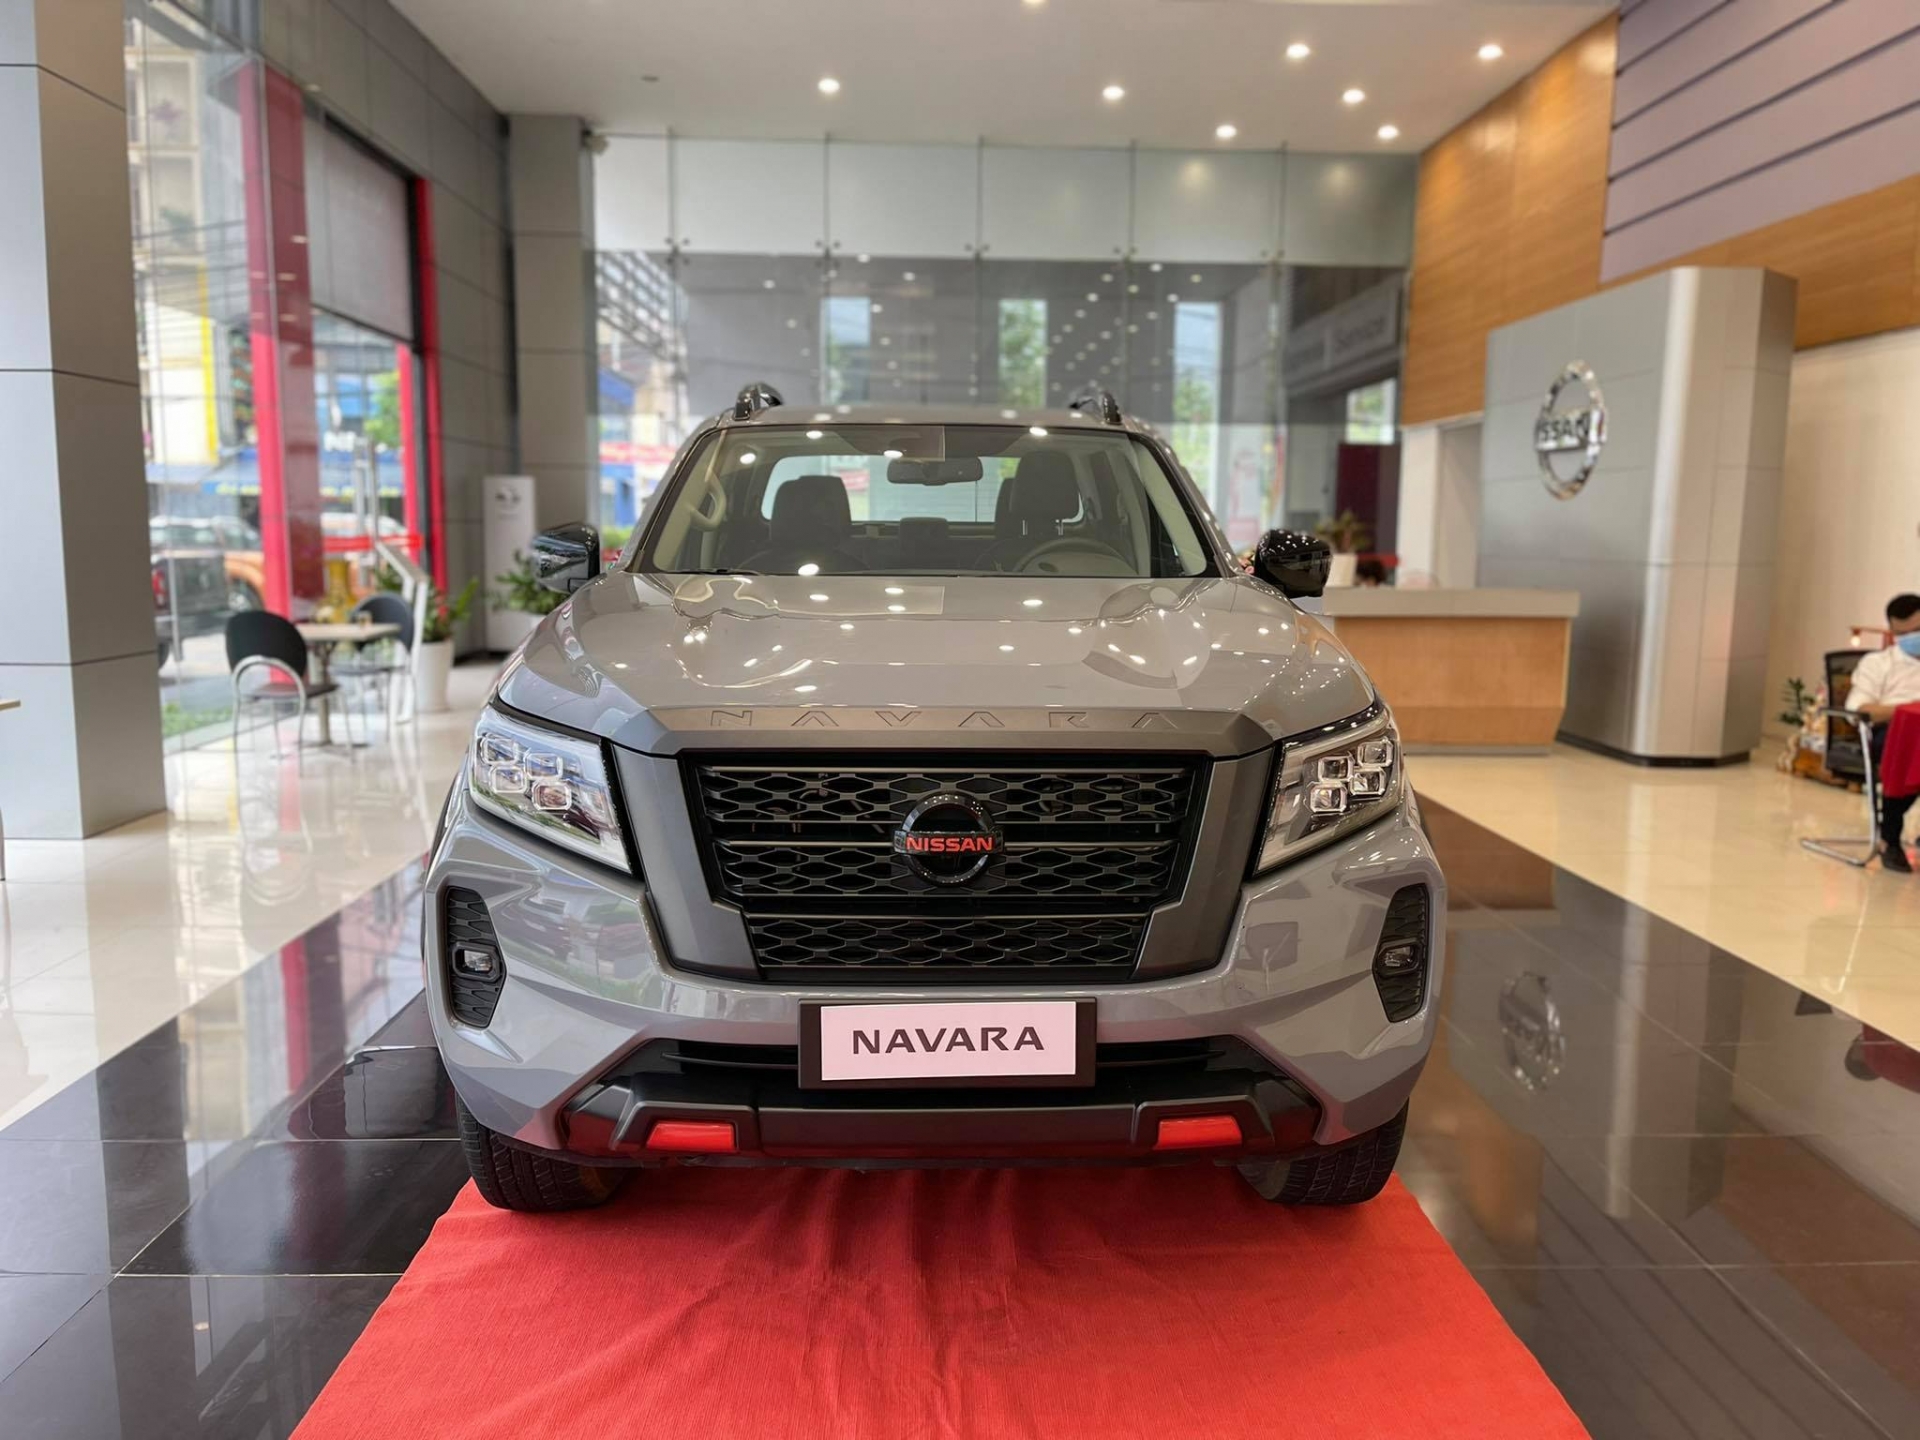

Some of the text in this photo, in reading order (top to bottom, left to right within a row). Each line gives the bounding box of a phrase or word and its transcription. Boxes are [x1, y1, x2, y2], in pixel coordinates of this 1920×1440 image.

[709, 709, 1179, 729] NAVARA
[906, 836, 993, 852] NISSAN
[852, 1026, 1045, 1054] NAVARA
